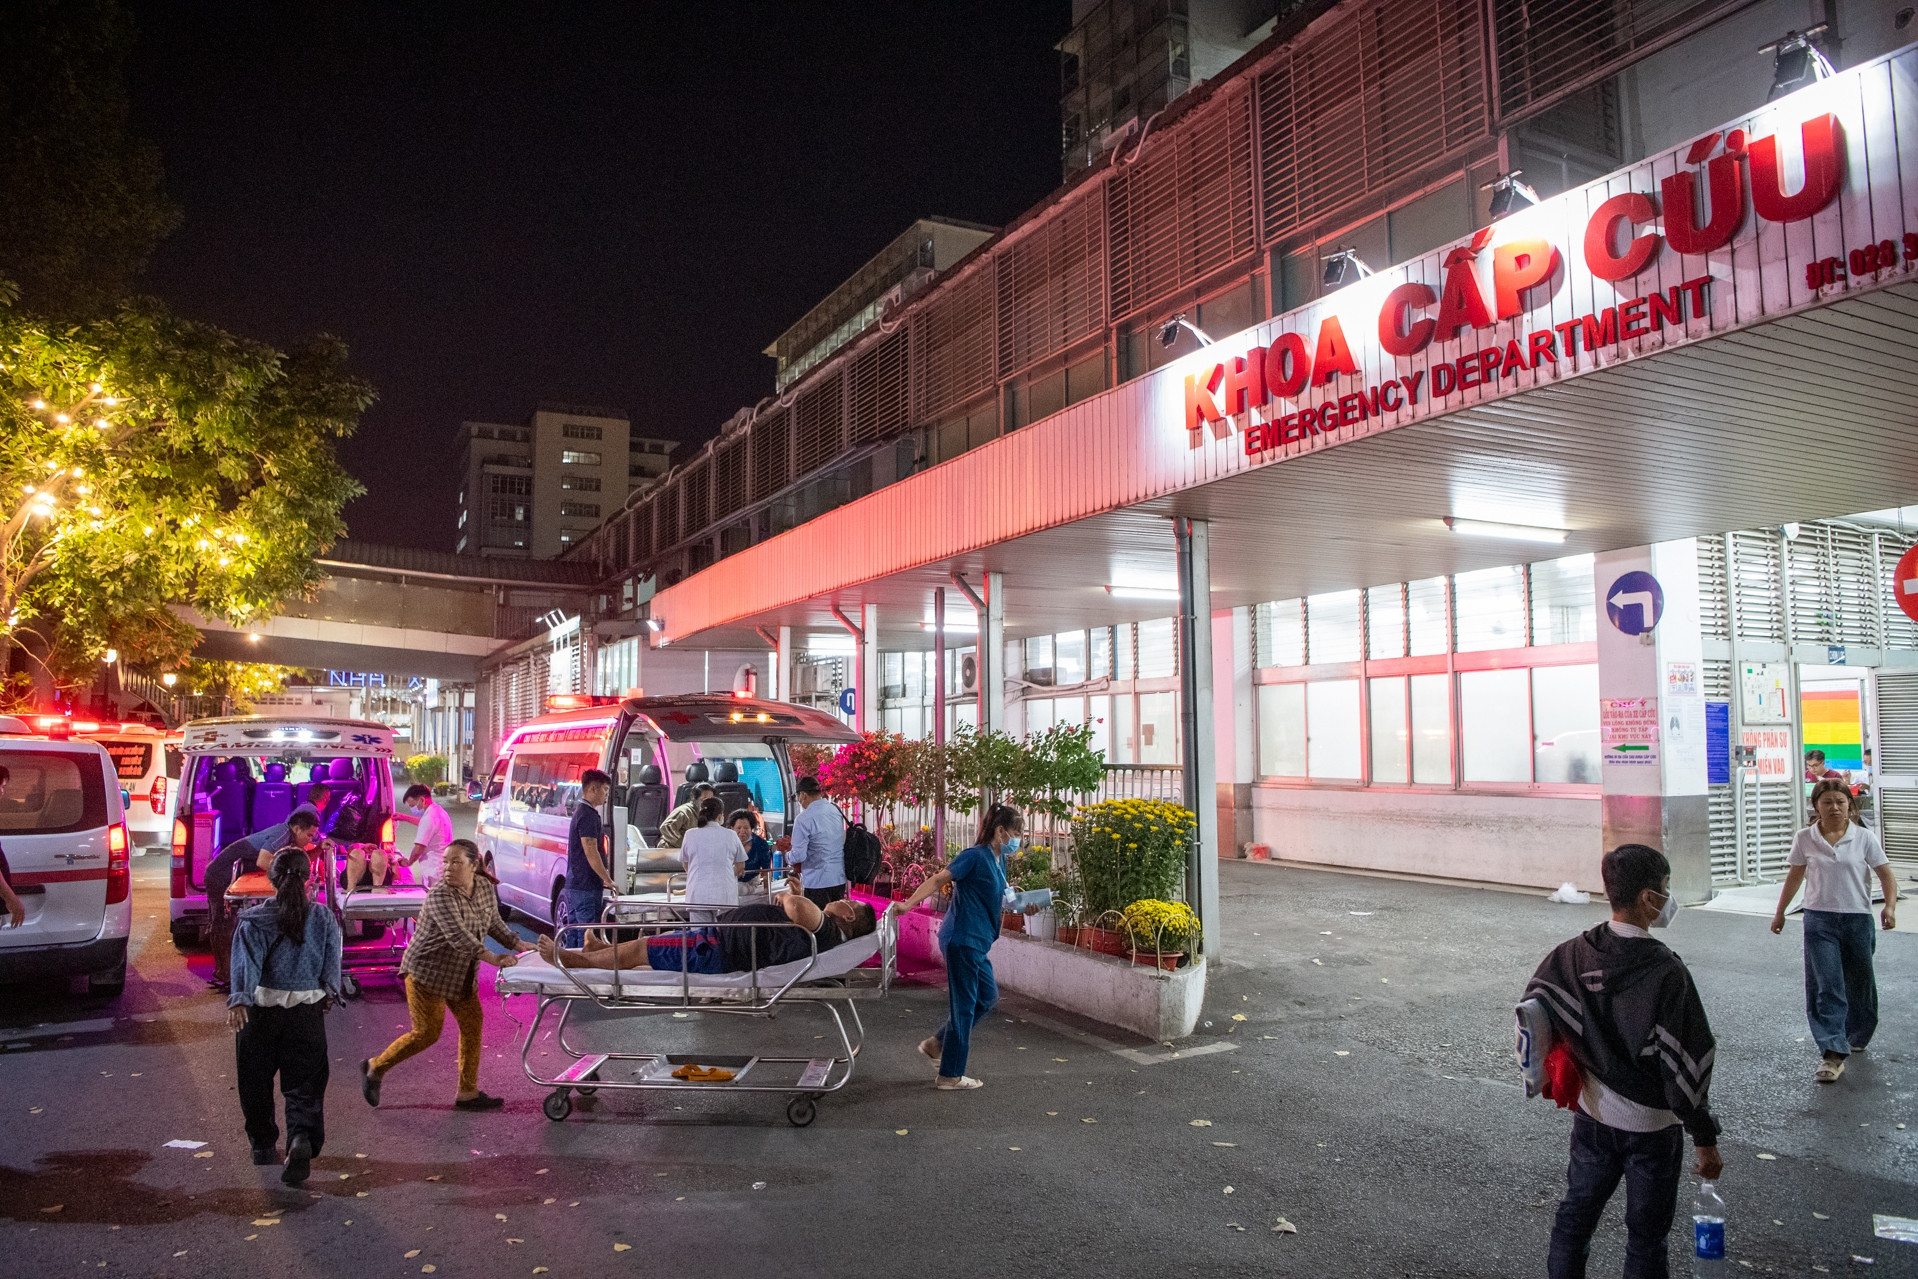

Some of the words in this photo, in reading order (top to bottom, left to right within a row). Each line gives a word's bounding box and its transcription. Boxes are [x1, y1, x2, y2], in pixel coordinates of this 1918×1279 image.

[1184, 315, 1358, 430] KHOA
[1378, 226, 1558, 357] CẤP
[1584, 112, 1846, 281] CỨU
[1849, 239, 1895, 276] 028
[1245, 371, 1424, 456] EMERGENCY
[1431, 275, 1714, 399] DEPARTMENT
